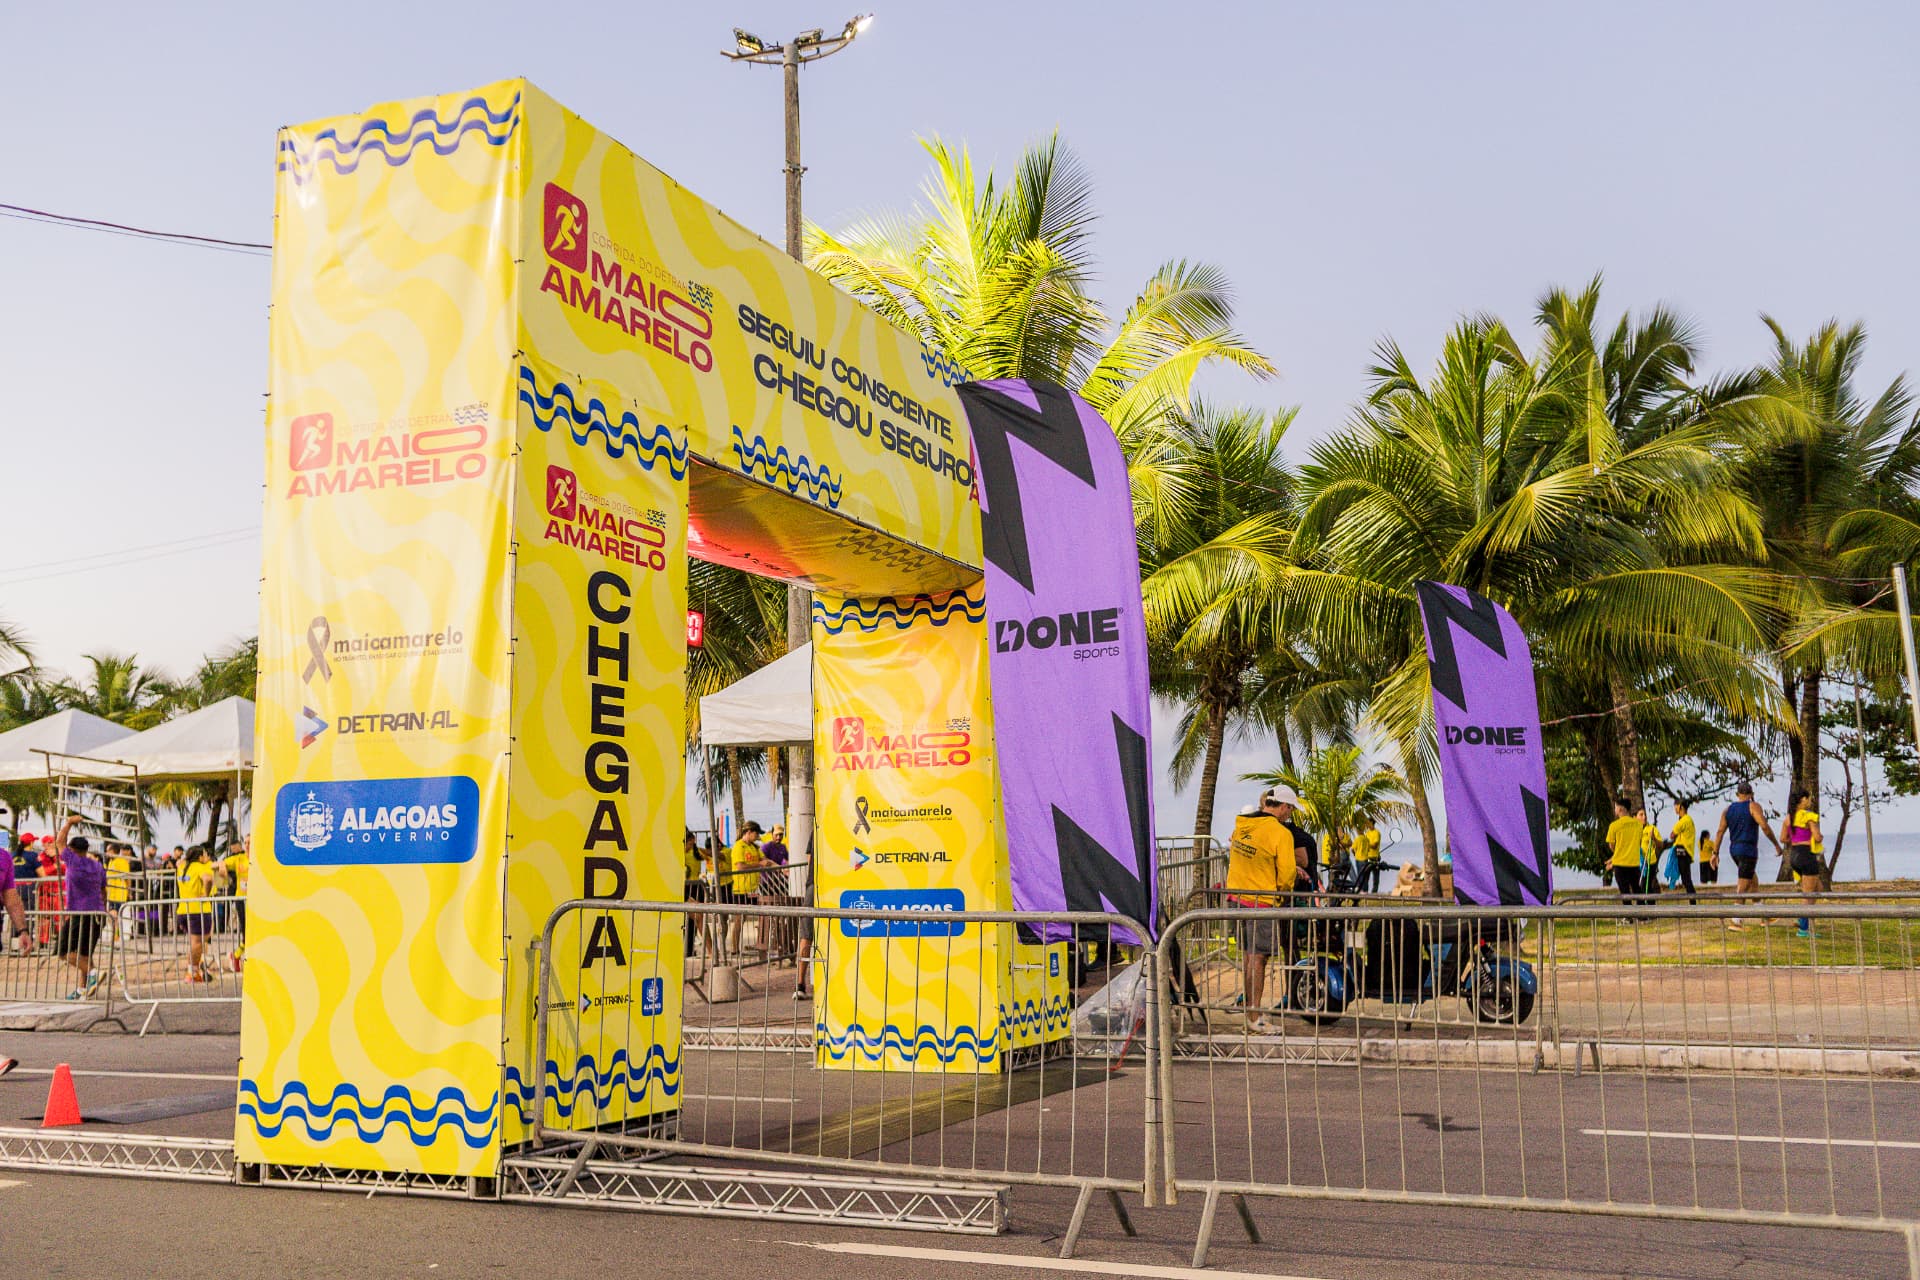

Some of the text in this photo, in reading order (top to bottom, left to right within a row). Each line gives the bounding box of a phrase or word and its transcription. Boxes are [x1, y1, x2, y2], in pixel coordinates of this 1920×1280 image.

[592, 231, 636, 264] CORRIDA
[640, 257, 653, 274] DO
[592, 250, 713, 340] MAIO
[540, 264, 713, 372] AMARELO
[738, 303, 954, 445] SEGUIU CONSCIENTE,
[753, 353, 873, 438] CHEGOU
[337, 425, 488, 466] MAIO
[286, 453, 487, 500] AMARELO
[544, 519, 666, 572] AMARELO
[579, 503, 666, 548] MAIO
[1073, 646, 1120, 662] sports
[831, 749, 971, 772] AMARELO
[866, 731, 971, 752] MAIO
[1495, 748, 1526, 756] sports
[581, 570, 632, 969] CHEGADA
[339, 804, 458, 831] ALAGOAS
[346, 830, 450, 843] GOVERNO
